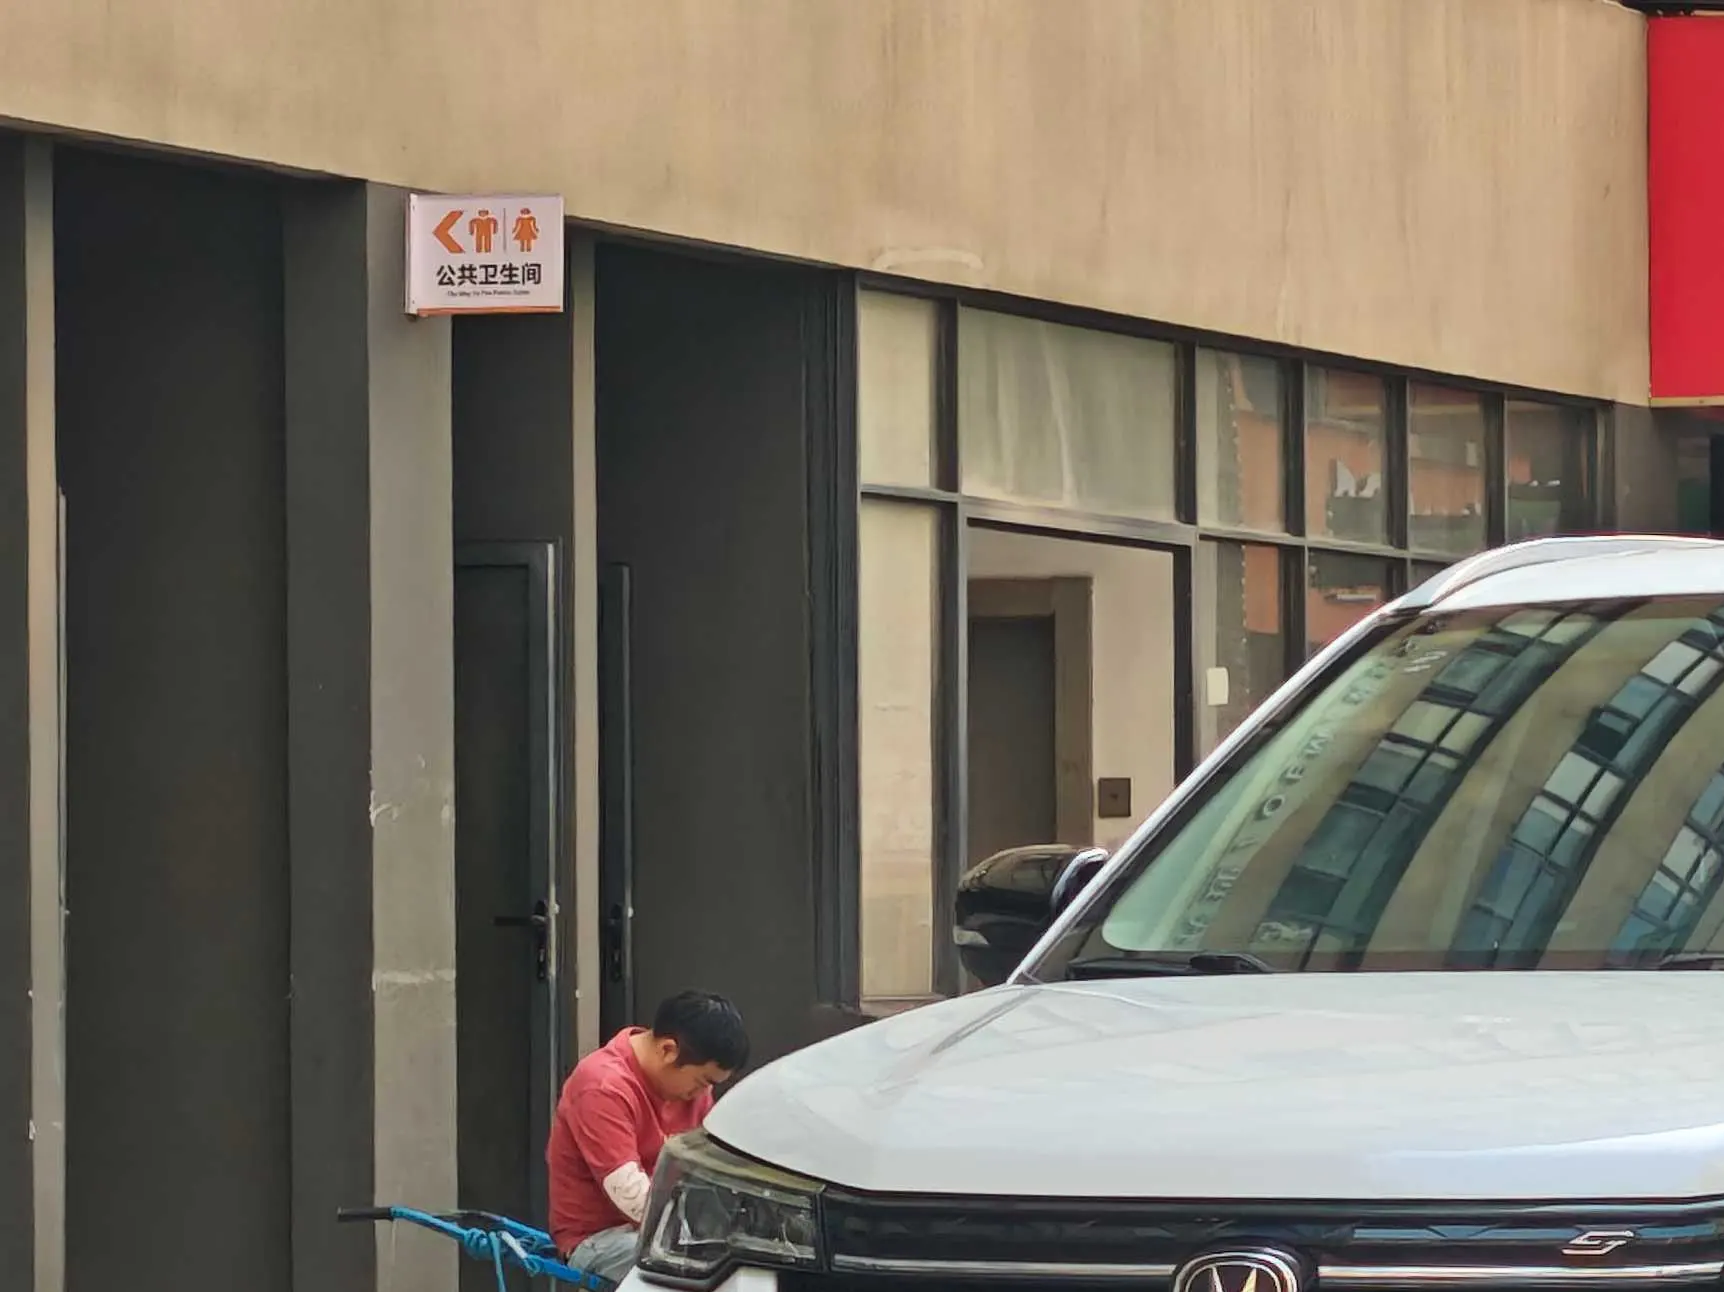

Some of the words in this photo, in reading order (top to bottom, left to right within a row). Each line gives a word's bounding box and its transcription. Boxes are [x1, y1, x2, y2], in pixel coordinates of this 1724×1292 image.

[436, 262, 542, 287] 公共卫生间
